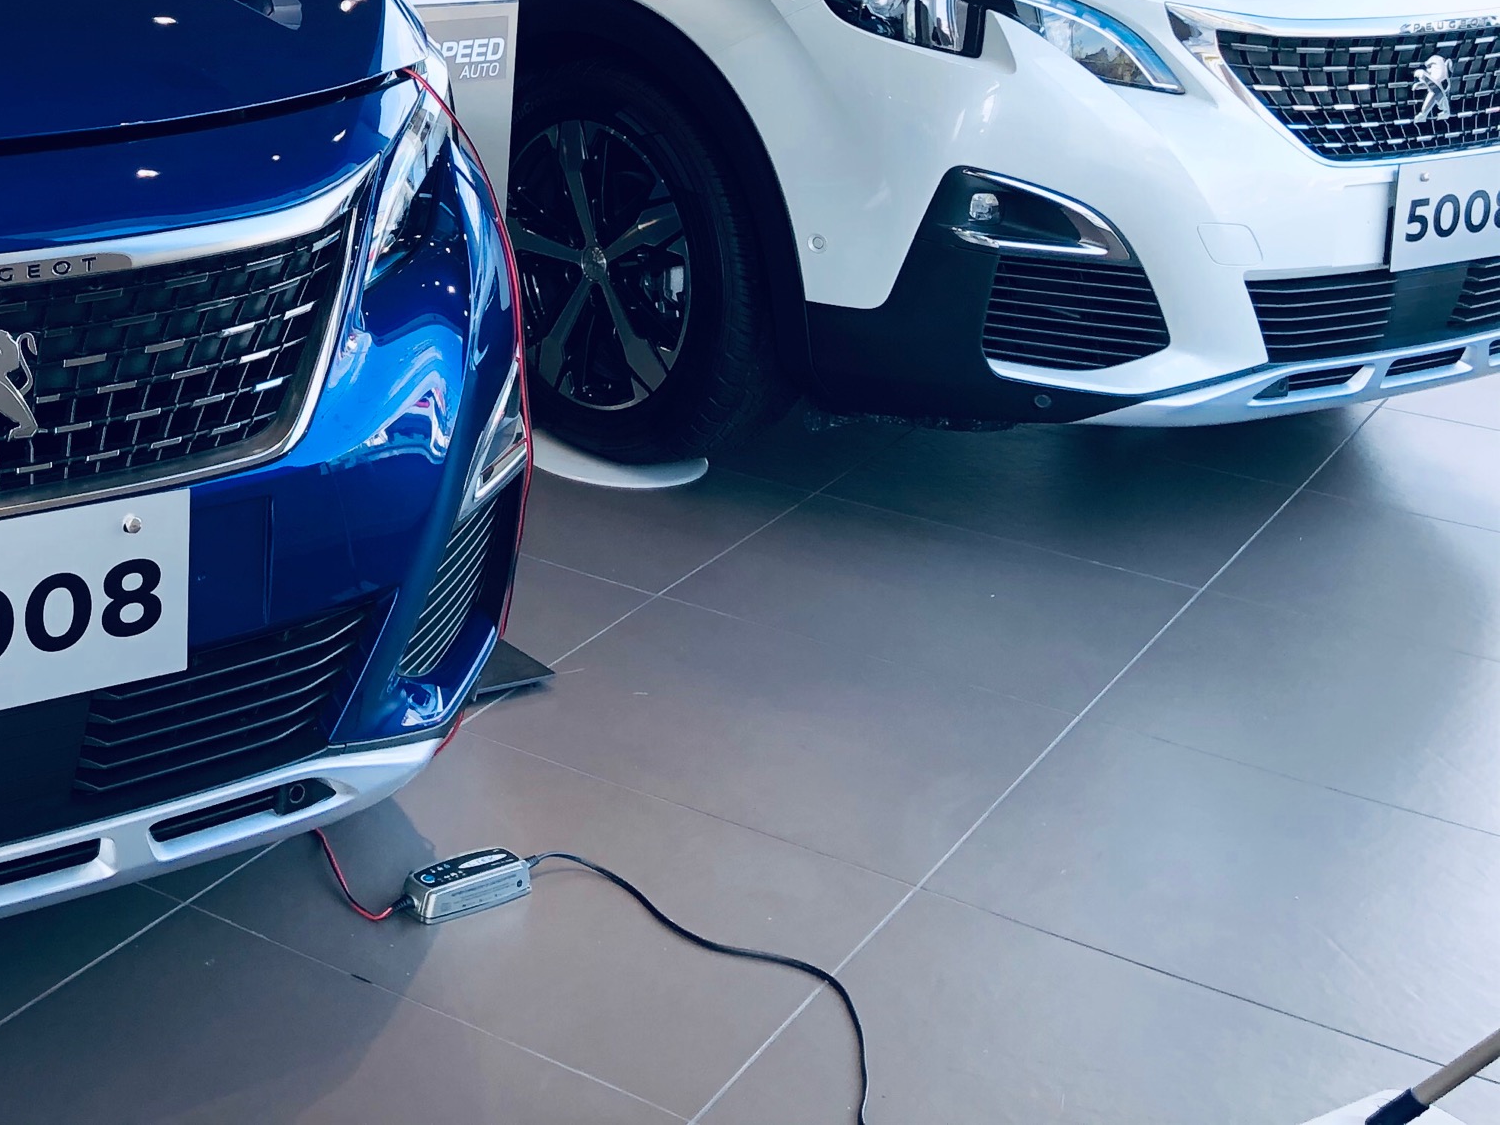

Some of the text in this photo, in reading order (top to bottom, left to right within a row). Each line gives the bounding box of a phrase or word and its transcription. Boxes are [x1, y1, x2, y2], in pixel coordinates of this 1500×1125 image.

[1413, 16, 1489, 32] PEUGEOT
[438, 37, 505, 63] PEED
[459, 62, 500, 79] AUTO
[1404, 189, 1500, 243] 500
